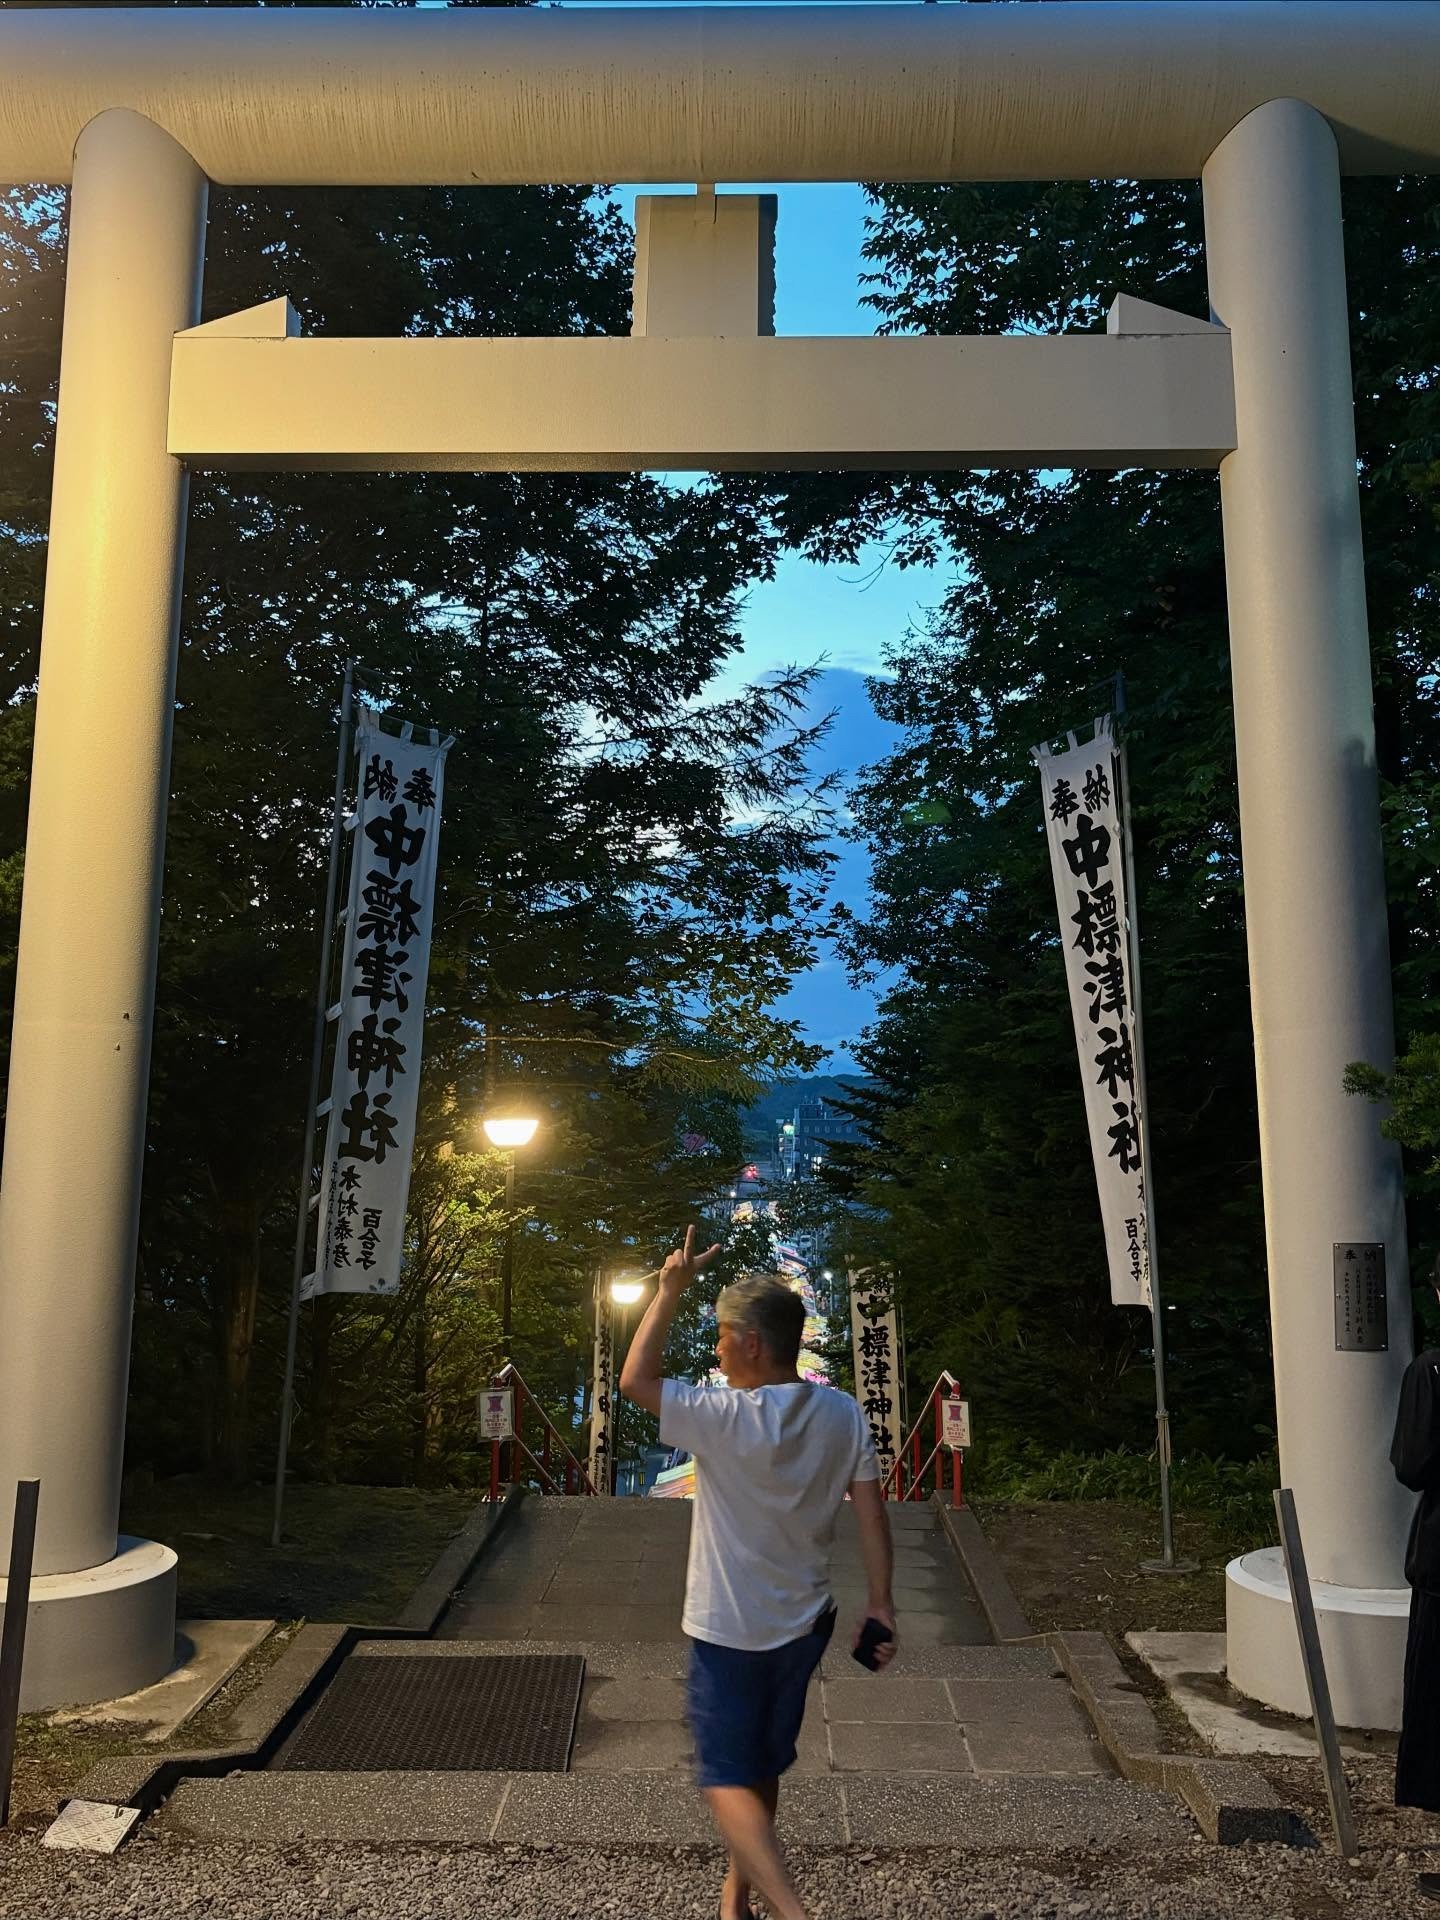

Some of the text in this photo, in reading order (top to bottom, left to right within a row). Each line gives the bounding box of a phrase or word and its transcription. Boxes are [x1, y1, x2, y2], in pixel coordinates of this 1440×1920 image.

[1049, 764, 1111, 826] 奉納
[1062, 814, 1142, 1174] 中標津神社
[1124, 1218, 1142, 1281] 百合子
